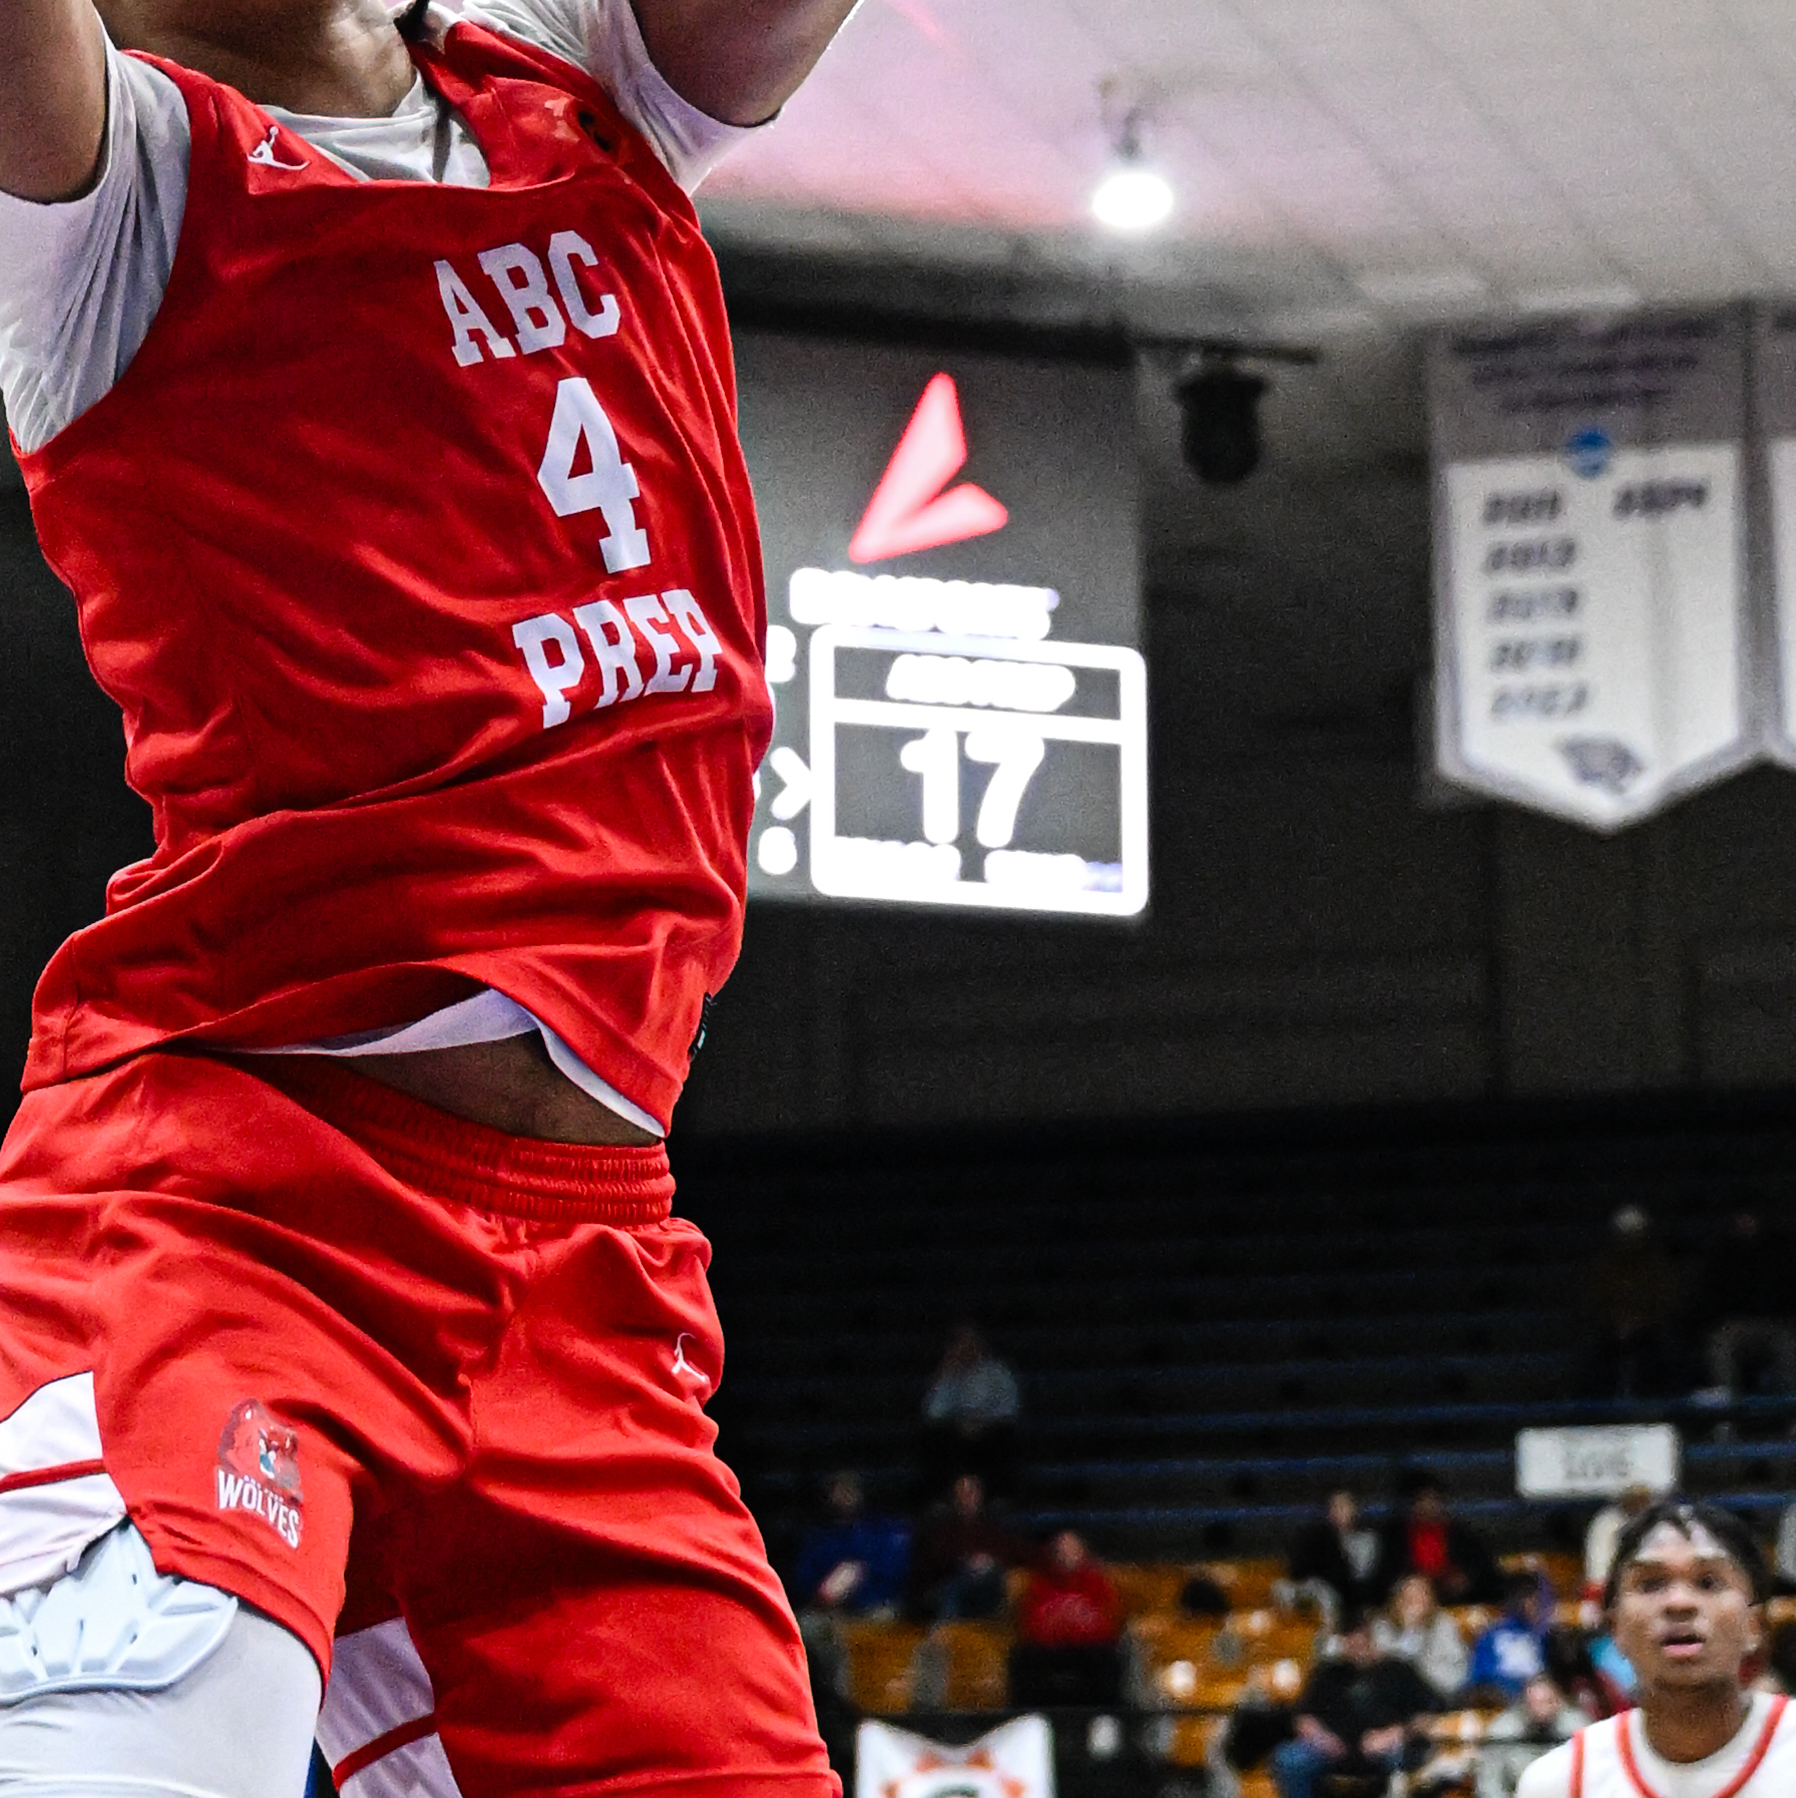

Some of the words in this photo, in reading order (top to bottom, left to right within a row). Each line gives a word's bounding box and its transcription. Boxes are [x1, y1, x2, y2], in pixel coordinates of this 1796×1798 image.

[433, 229, 621, 368] ABC
[536, 376, 651, 574] 4
[512, 588, 724, 730] PREP
[900, 727, 1046, 849] 17
[216, 1468, 301, 1549] WOLVES
